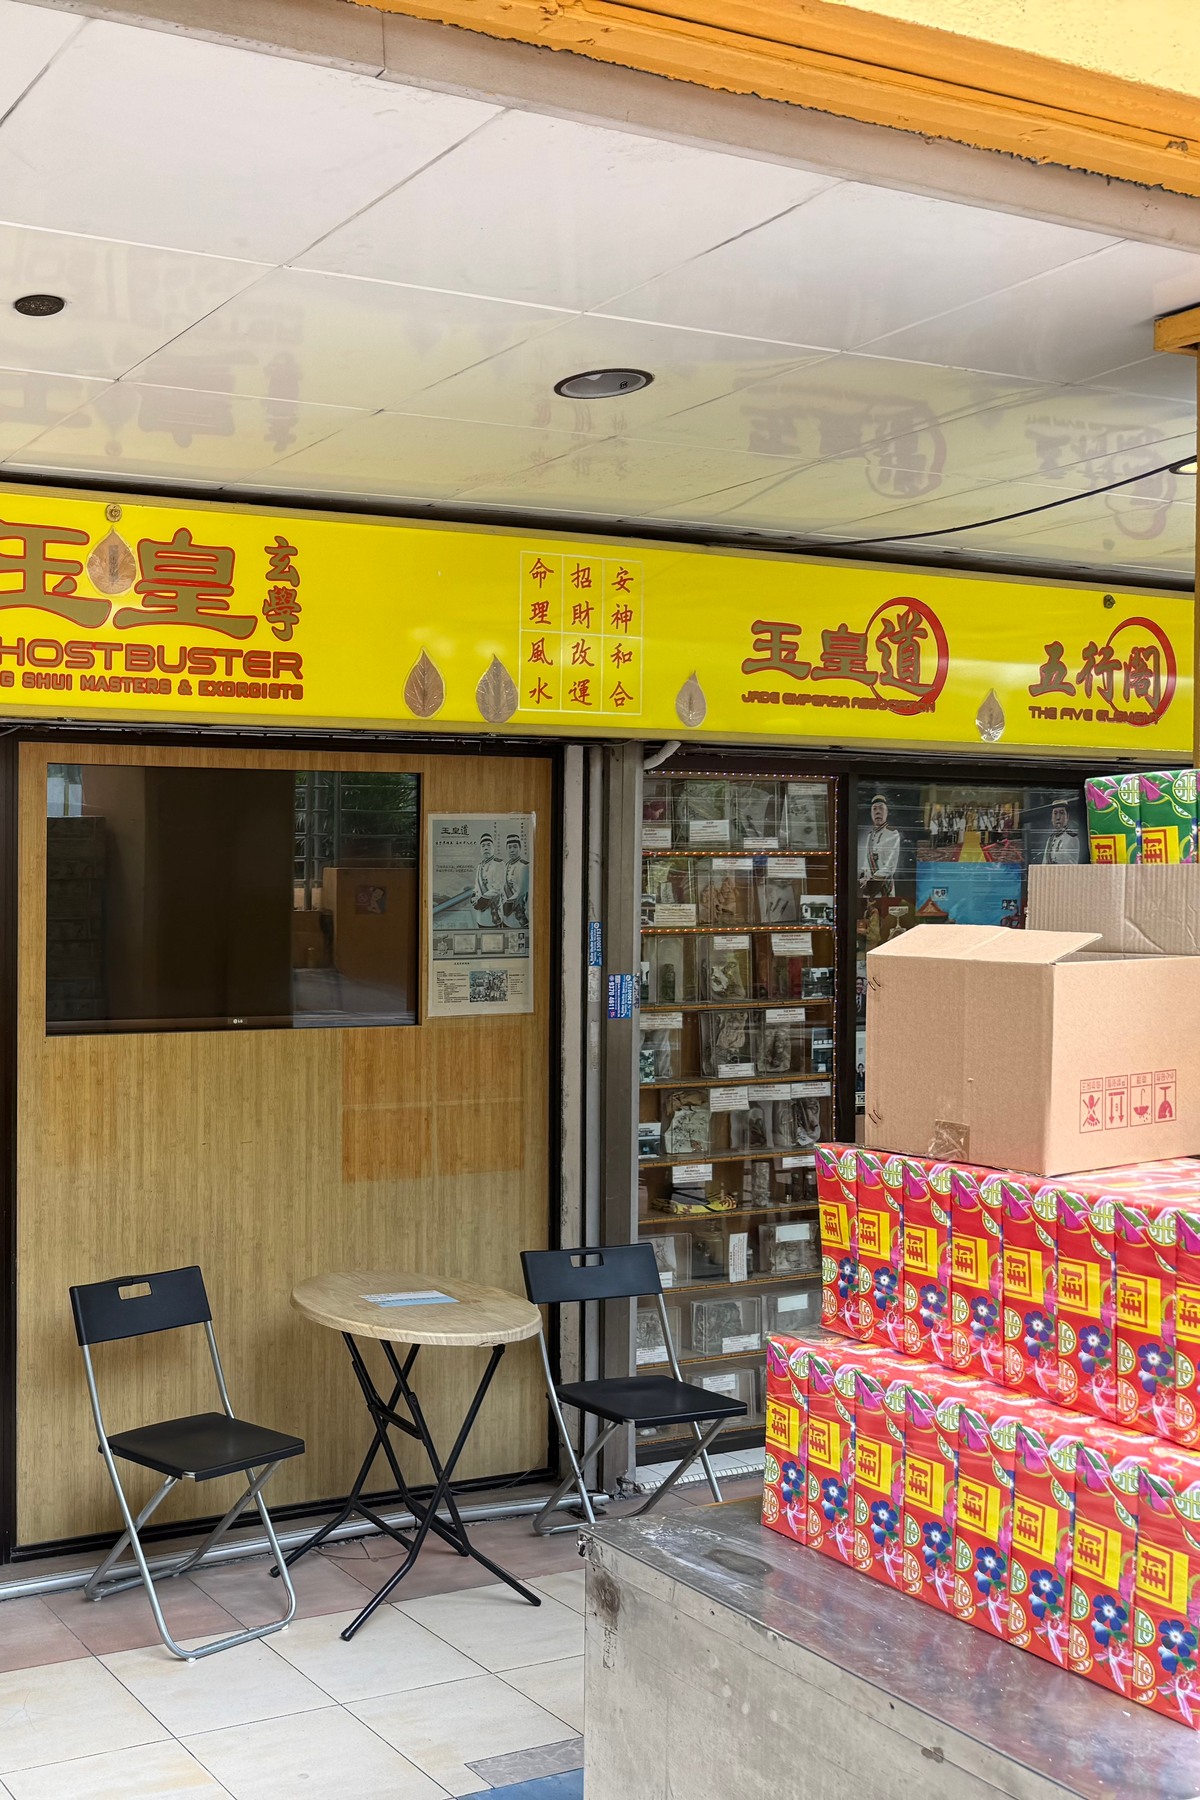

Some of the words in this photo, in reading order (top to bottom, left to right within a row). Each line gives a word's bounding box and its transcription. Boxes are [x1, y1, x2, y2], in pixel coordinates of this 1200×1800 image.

[262, 535, 303, 641] 玄學
[528, 558, 555, 704] 命理風水
[568, 563, 595, 706] 招財改運
[609, 566, 634, 707] 安神和合
[741, 605, 936, 697] 玉皇道
[21, 671, 73, 691] SHUI
[80, 674, 172, 695] MASTERS
[177, 679, 193, 696] &
[198, 679, 304, 701] EXORCISTS
[741, 690, 780, 704] JADE
[782, 692, 851, 708] EMPEROR
[1028, 705, 1058, 720] THE
[1060, 707, 1093, 722] FIVE
[823, 1209, 839, 1238] 封
[860, 1217, 877, 1246] 封
[906, 1231, 923, 1263] 封
[955, 1242, 974, 1274] 封
[1006, 1255, 1027, 1288] 封
[1061, 1267, 1083, 1301] 封
[1120, 1282, 1142, 1318] 封
[771, 1407, 788, 1440] 封
[809, 1423, 827, 1456] 封
[858, 1443, 877, 1478] 封
[909, 1463, 929, 1498] 封
[962, 1485, 983, 1522] 封
[1016, 1505, 1040, 1544] 封
[1077, 1527, 1102, 1568] 封
[1140, 1549, 1167, 1592] 封
